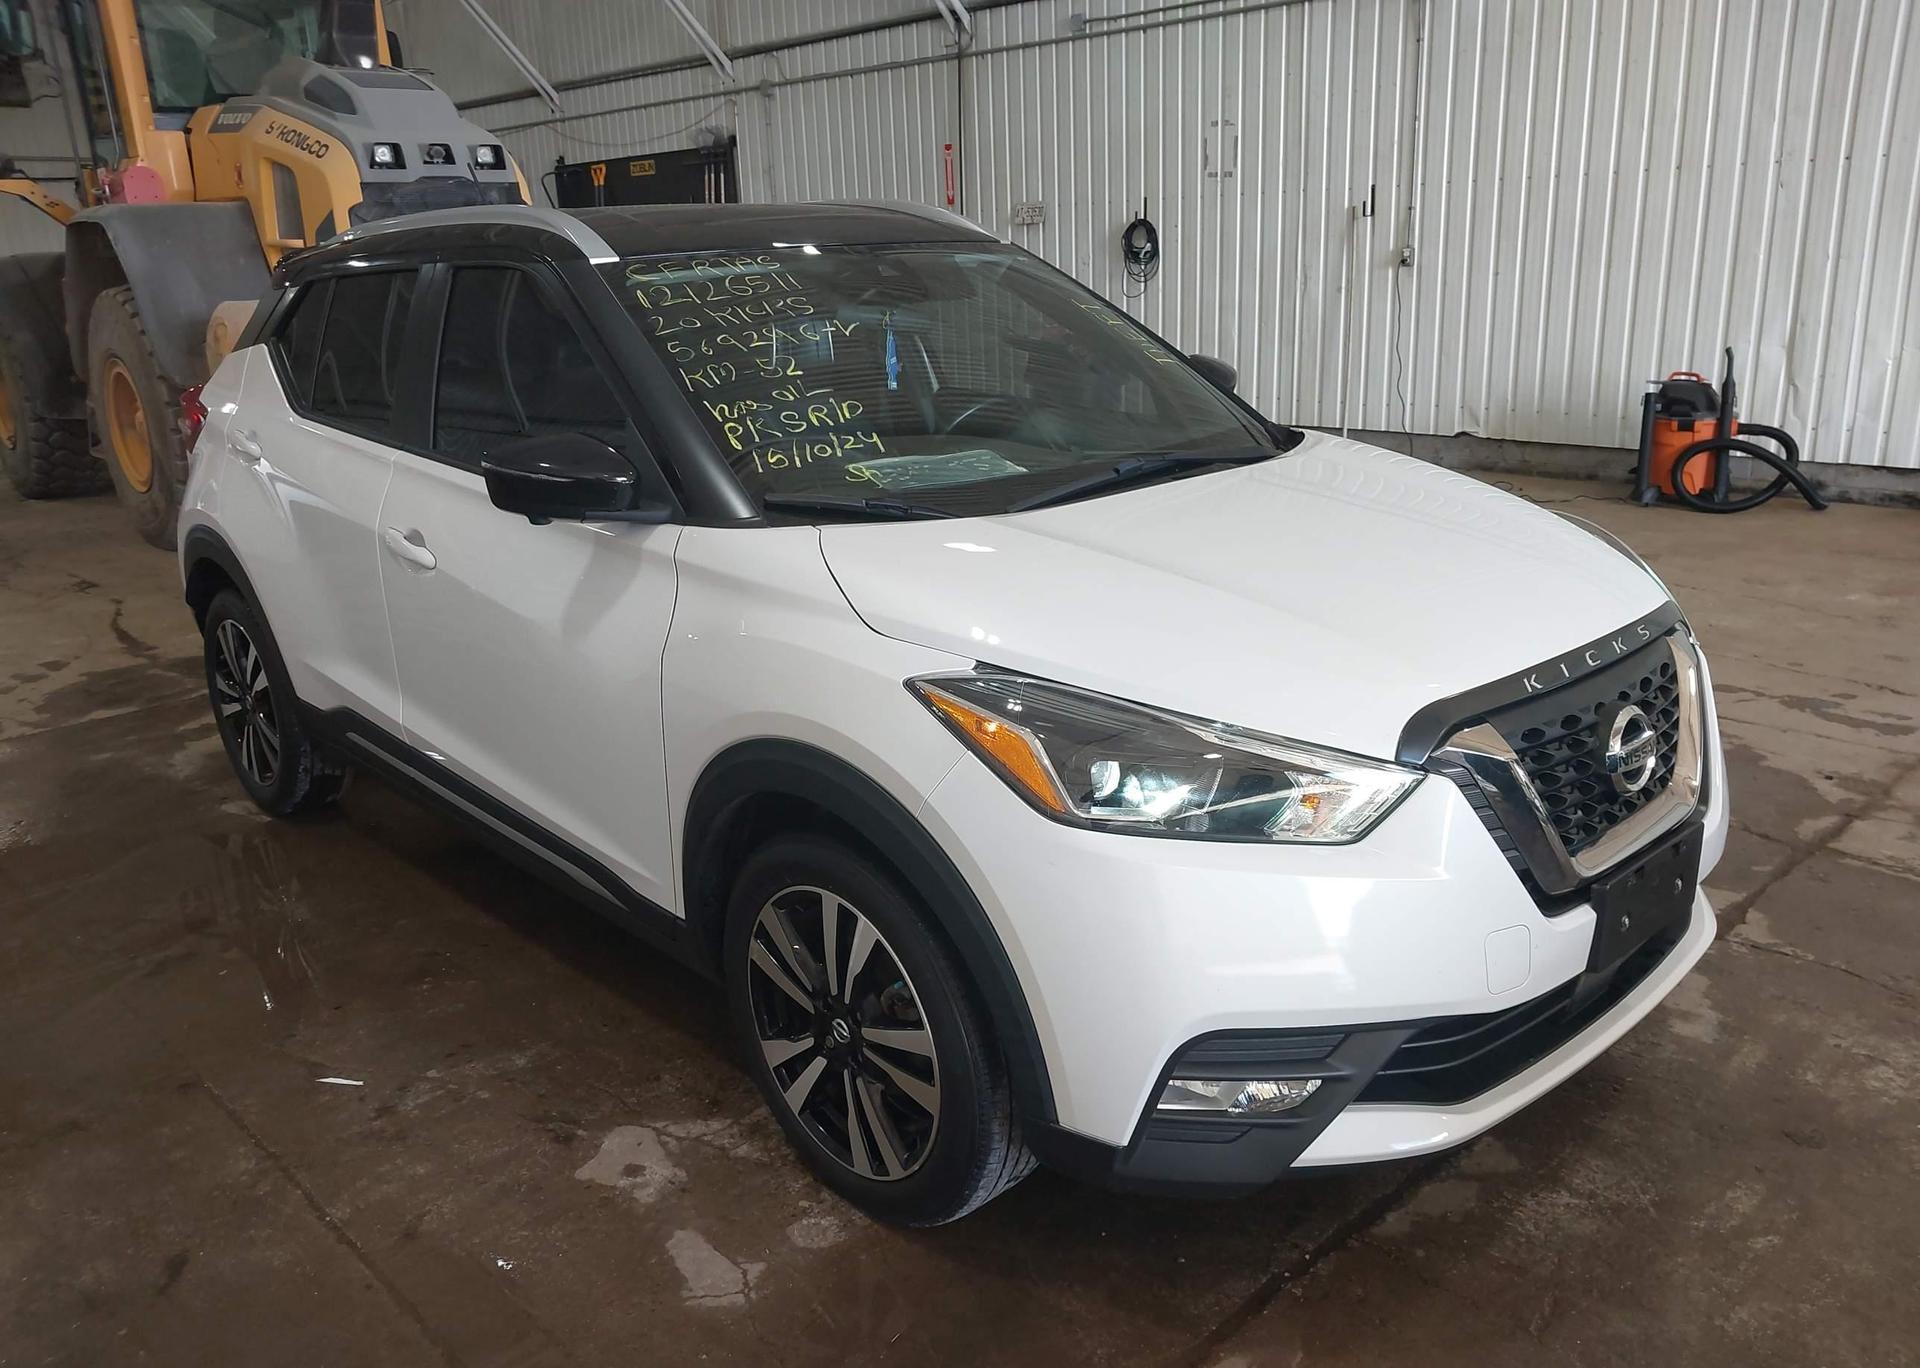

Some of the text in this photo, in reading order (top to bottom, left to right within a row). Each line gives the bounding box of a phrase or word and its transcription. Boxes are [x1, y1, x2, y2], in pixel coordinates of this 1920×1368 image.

[703, 296, 814, 327] KICKS
[752, 431, 886, 473] 15/10/24
[1522, 624, 1651, 693] KICKS
